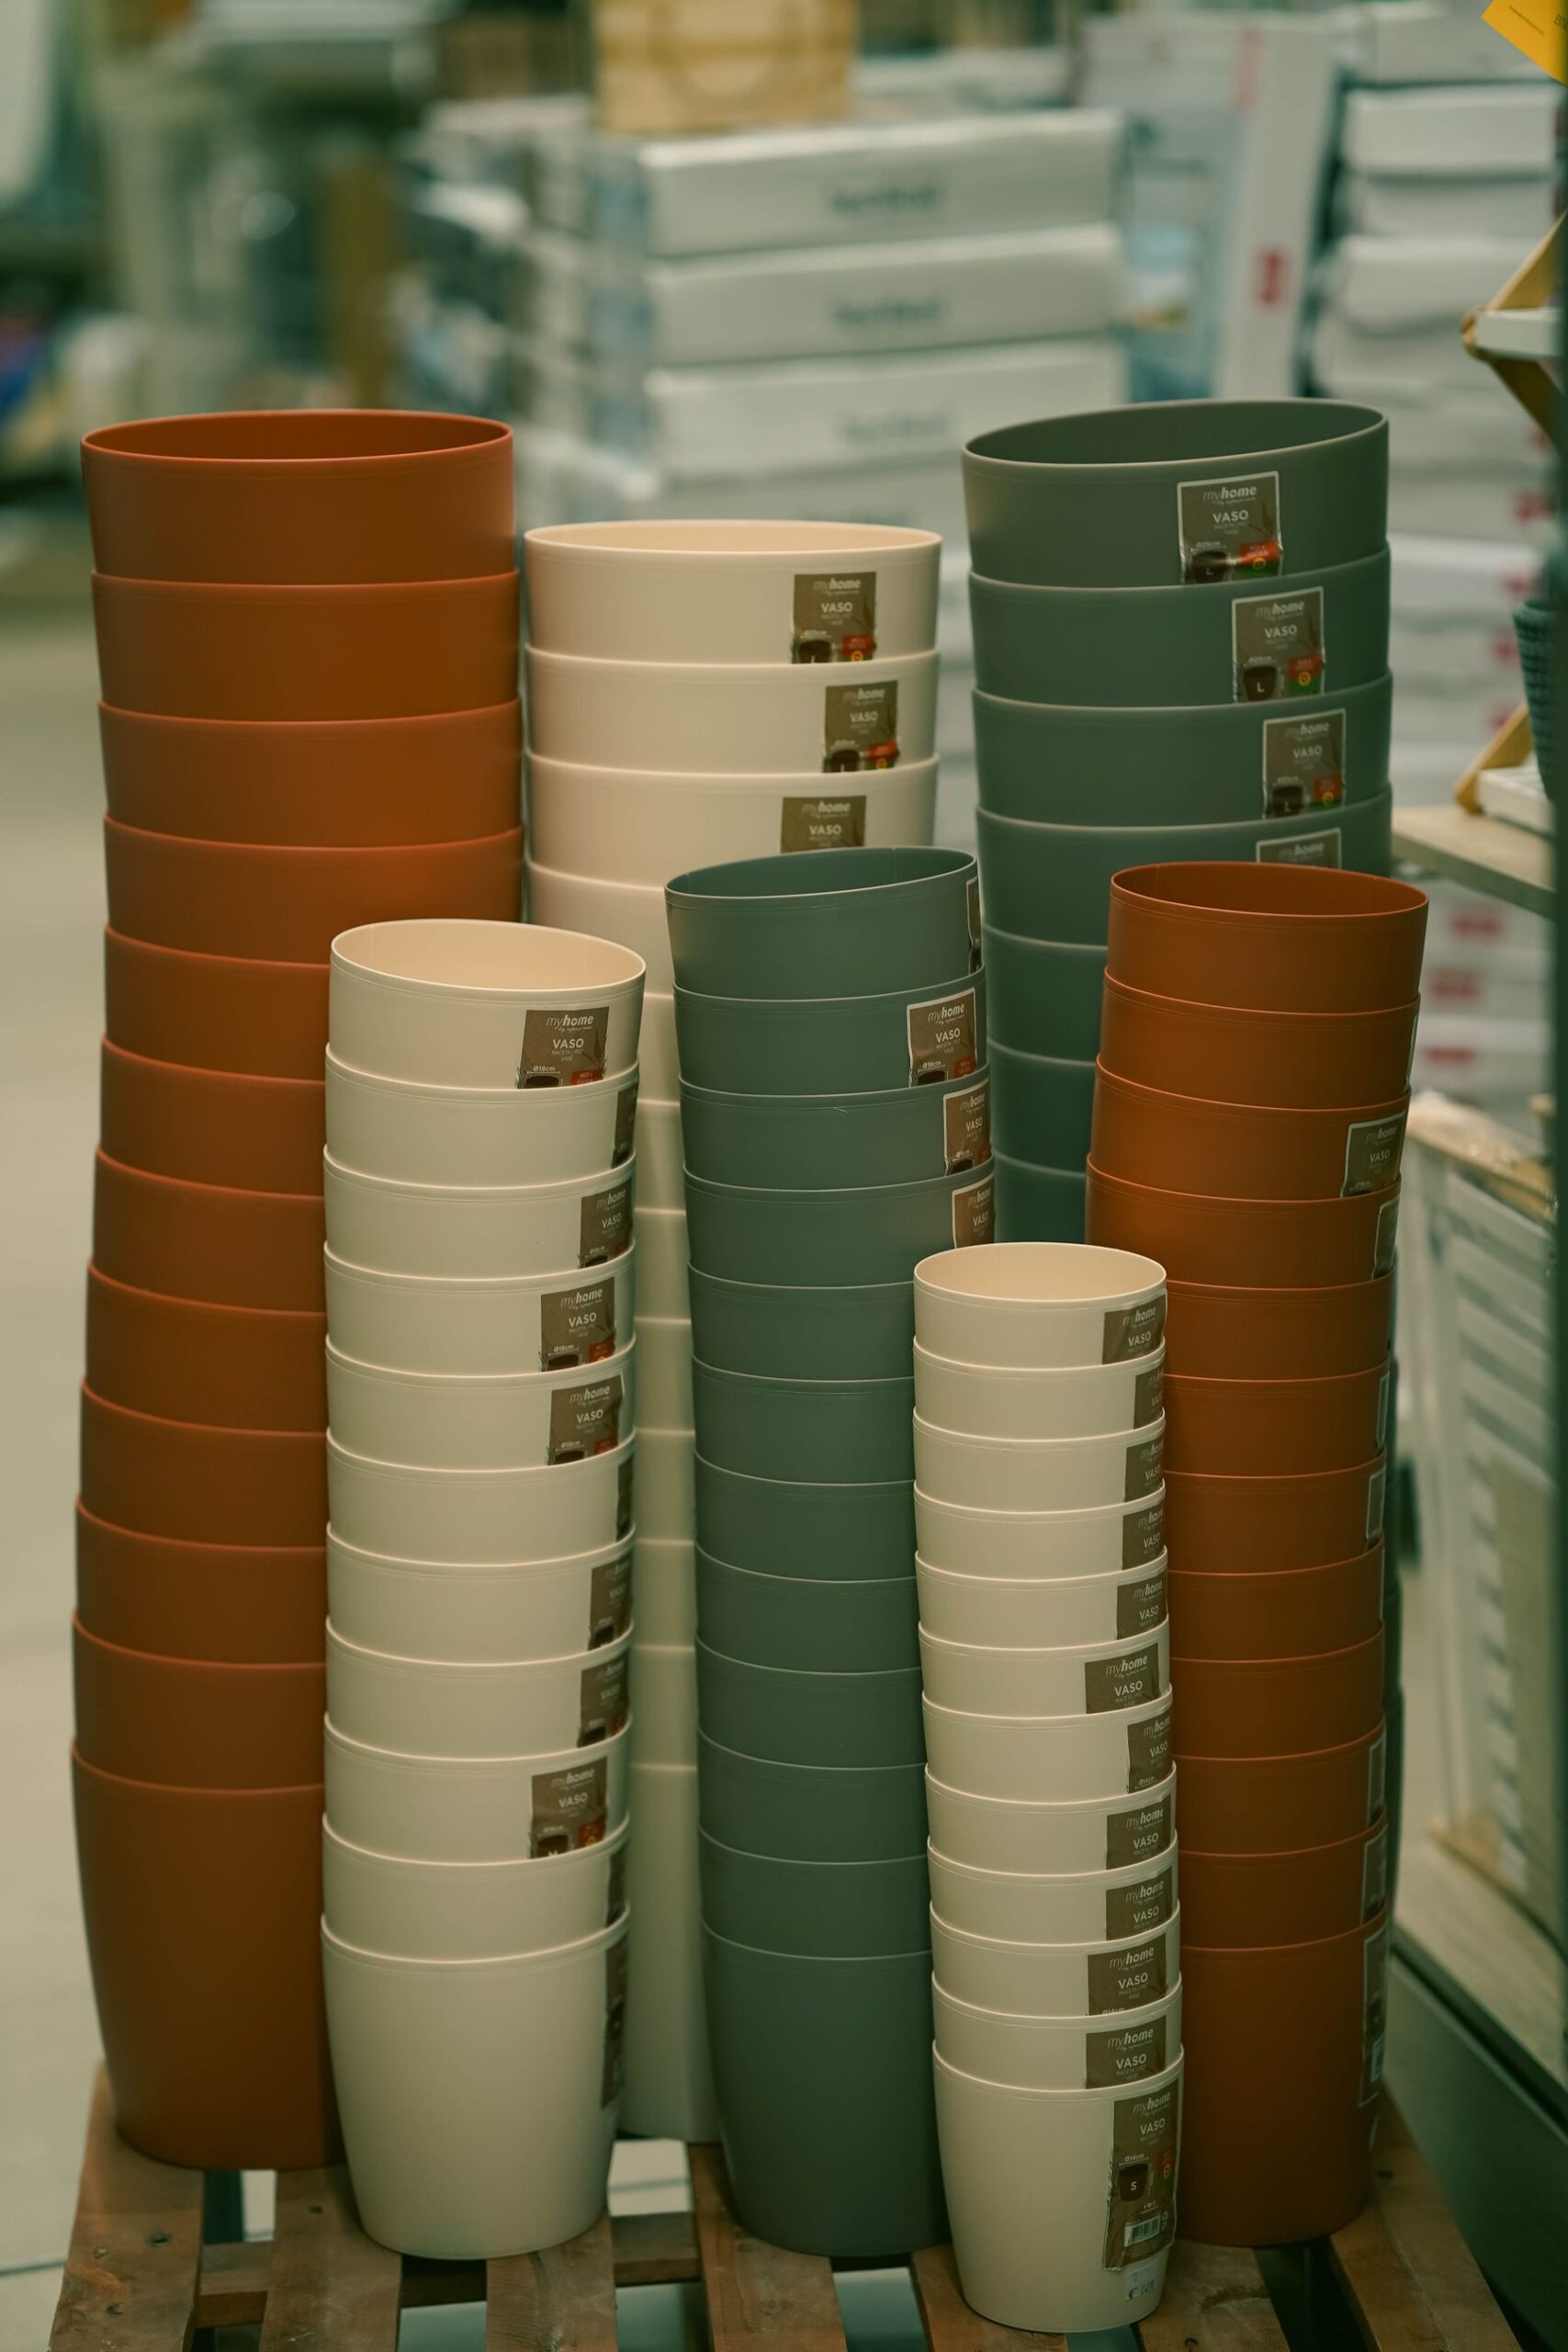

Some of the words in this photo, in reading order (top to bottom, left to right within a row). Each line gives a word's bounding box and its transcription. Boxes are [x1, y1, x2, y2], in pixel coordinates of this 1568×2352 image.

[1203, 486, 1258, 503] myhome
[1213, 510, 1249, 524] VASO
[820, 602, 853, 613] VASO
[1264, 625, 1298, 639] VASO
[1257, 682, 1265, 693] L
[849, 711, 879, 723] VASO
[1292, 745, 1324, 758] VASO
[808, 824, 842, 835] VASO
[928, 1003, 965, 1023] myhome
[546, 1014, 594, 1030] myhome
[935, 1027, 961, 1043] VASO
[552, 1038, 585, 1049] VASO
[965, 1116, 983, 1132] VASO
[1370, 1149, 1391, 1163] VASO
[602, 1212, 623, 1228] VASO
[560, 1289, 604, 1309] myhome
[568, 1312, 598, 1328] VASO
[1128, 1331, 1152, 1347] VASO
[570, 1385, 611, 1404] myhome
[576, 1408, 604, 1424] VASO
[1139, 1605, 1159, 1621] VASO
[1105, 1655, 1148, 1678] myhome
[1114, 1680, 1144, 1697] VASO
[1149, 1741, 1168, 1758] VASO
[558, 1792, 588, 1808] VASO
[1133, 1832, 1159, 1849] VASO
[1124, 1881, 1165, 1904] myhome
[1133, 1905, 1159, 1923] VASO
[1109, 1947, 1155, 1970] myhome
[1118, 1973, 1148, 1990] VASO
[1107, 2029, 1155, 2050] myhome
[1115, 2053, 1147, 2070] VASO
[1132, 2092, 1172, 2115] myhome
[1139, 2118, 1167, 2135] VASO
[1130, 2181, 1137, 2191] S
